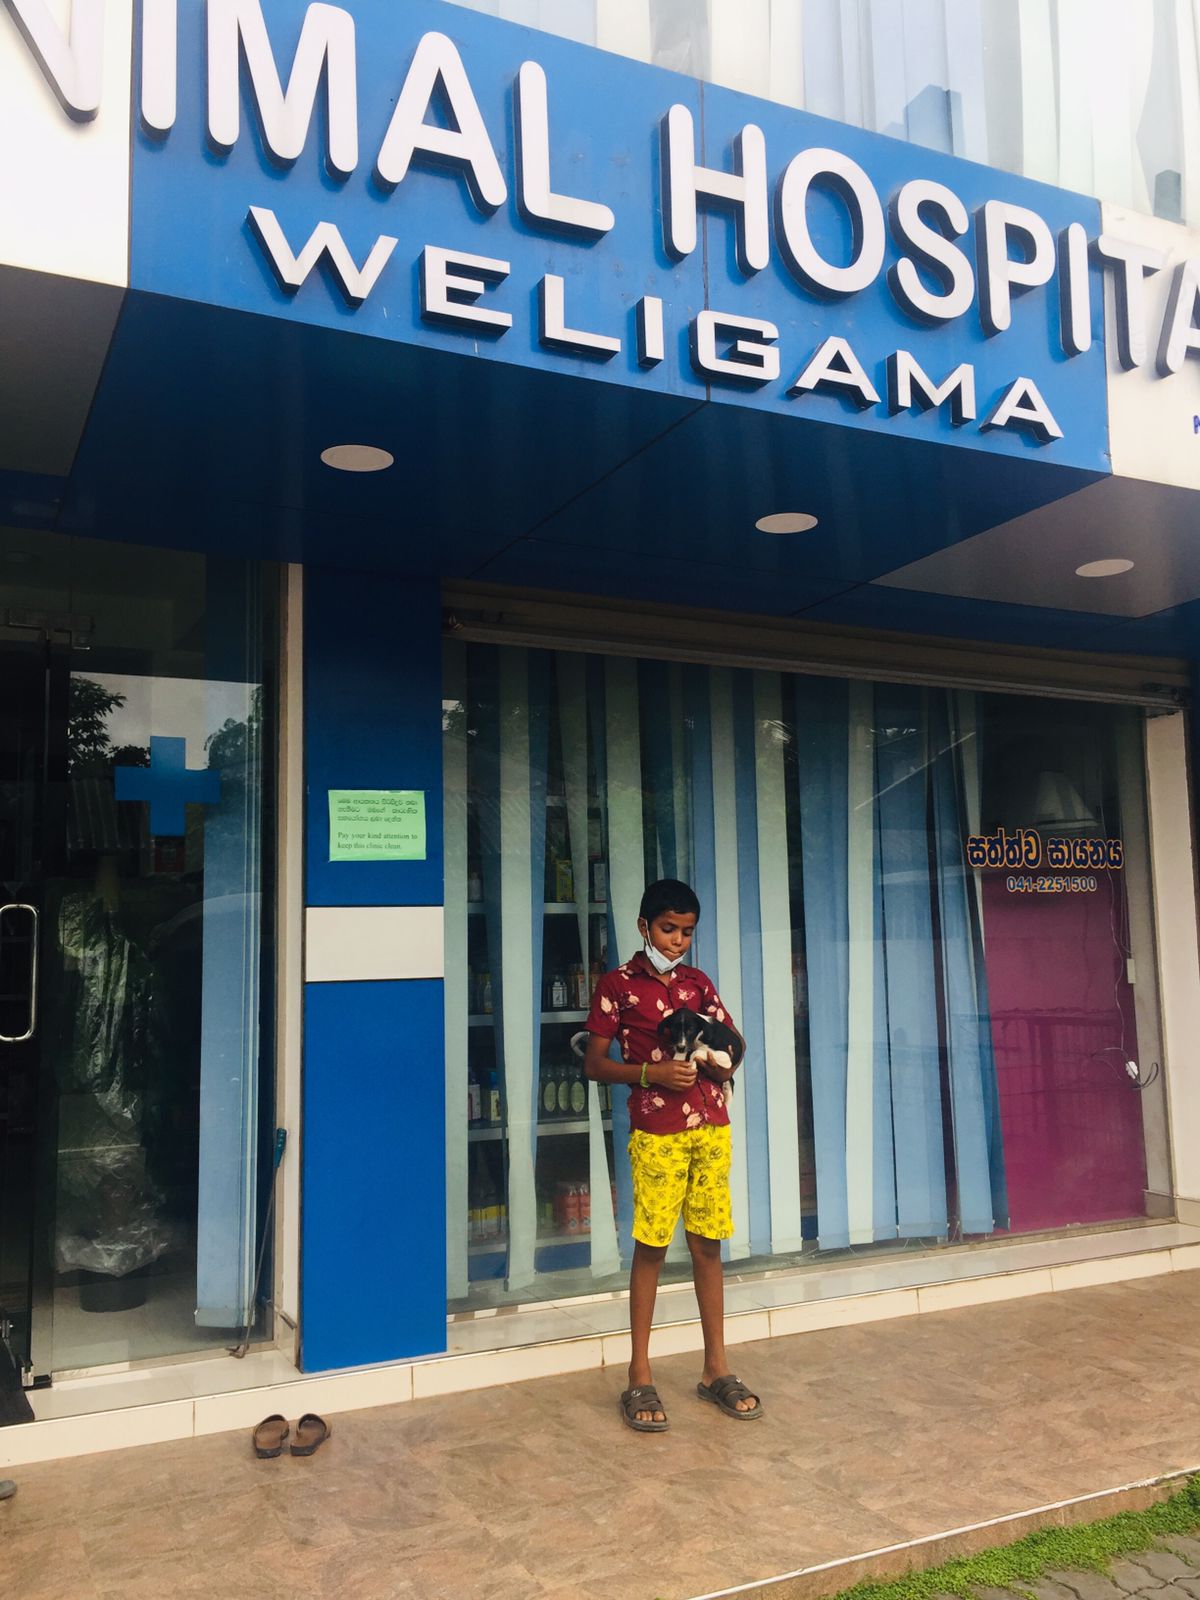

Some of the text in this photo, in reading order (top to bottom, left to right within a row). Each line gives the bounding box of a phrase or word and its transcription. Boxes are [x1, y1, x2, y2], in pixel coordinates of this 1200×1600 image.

[246, 204, 1064, 445] WELIGAMA
[338, 832, 349, 840] Pay
[338, 842, 353, 850] keep
[968, 828, 1123, 868] සත්ත්ව සායනය
[1007, 876, 1097, 892] 041-2251500
